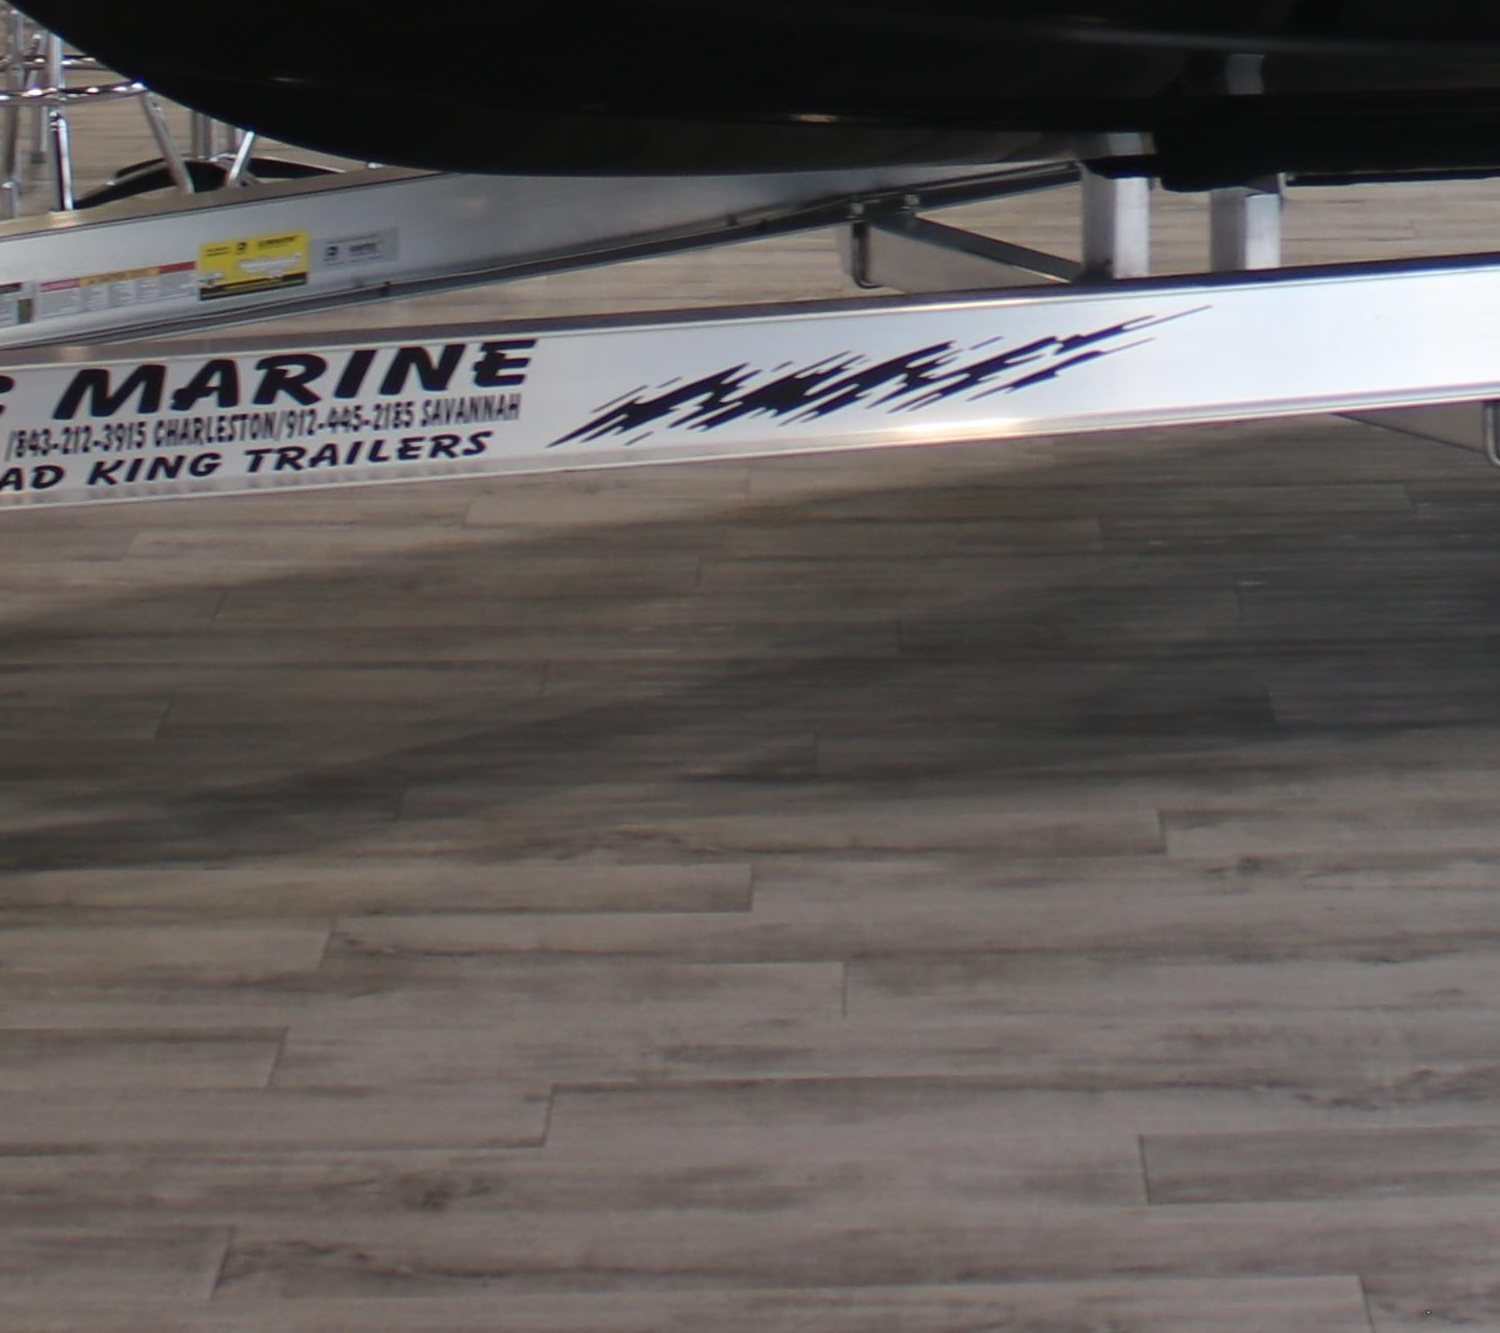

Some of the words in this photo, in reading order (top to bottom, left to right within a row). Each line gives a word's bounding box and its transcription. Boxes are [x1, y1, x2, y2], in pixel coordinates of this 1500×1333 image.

[52, 339, 539, 420] MARINE
[421, 393, 521, 427] SAVANNAH
[86, 452, 222, 487] KING
[245, 431, 494, 474] TRAILERS
